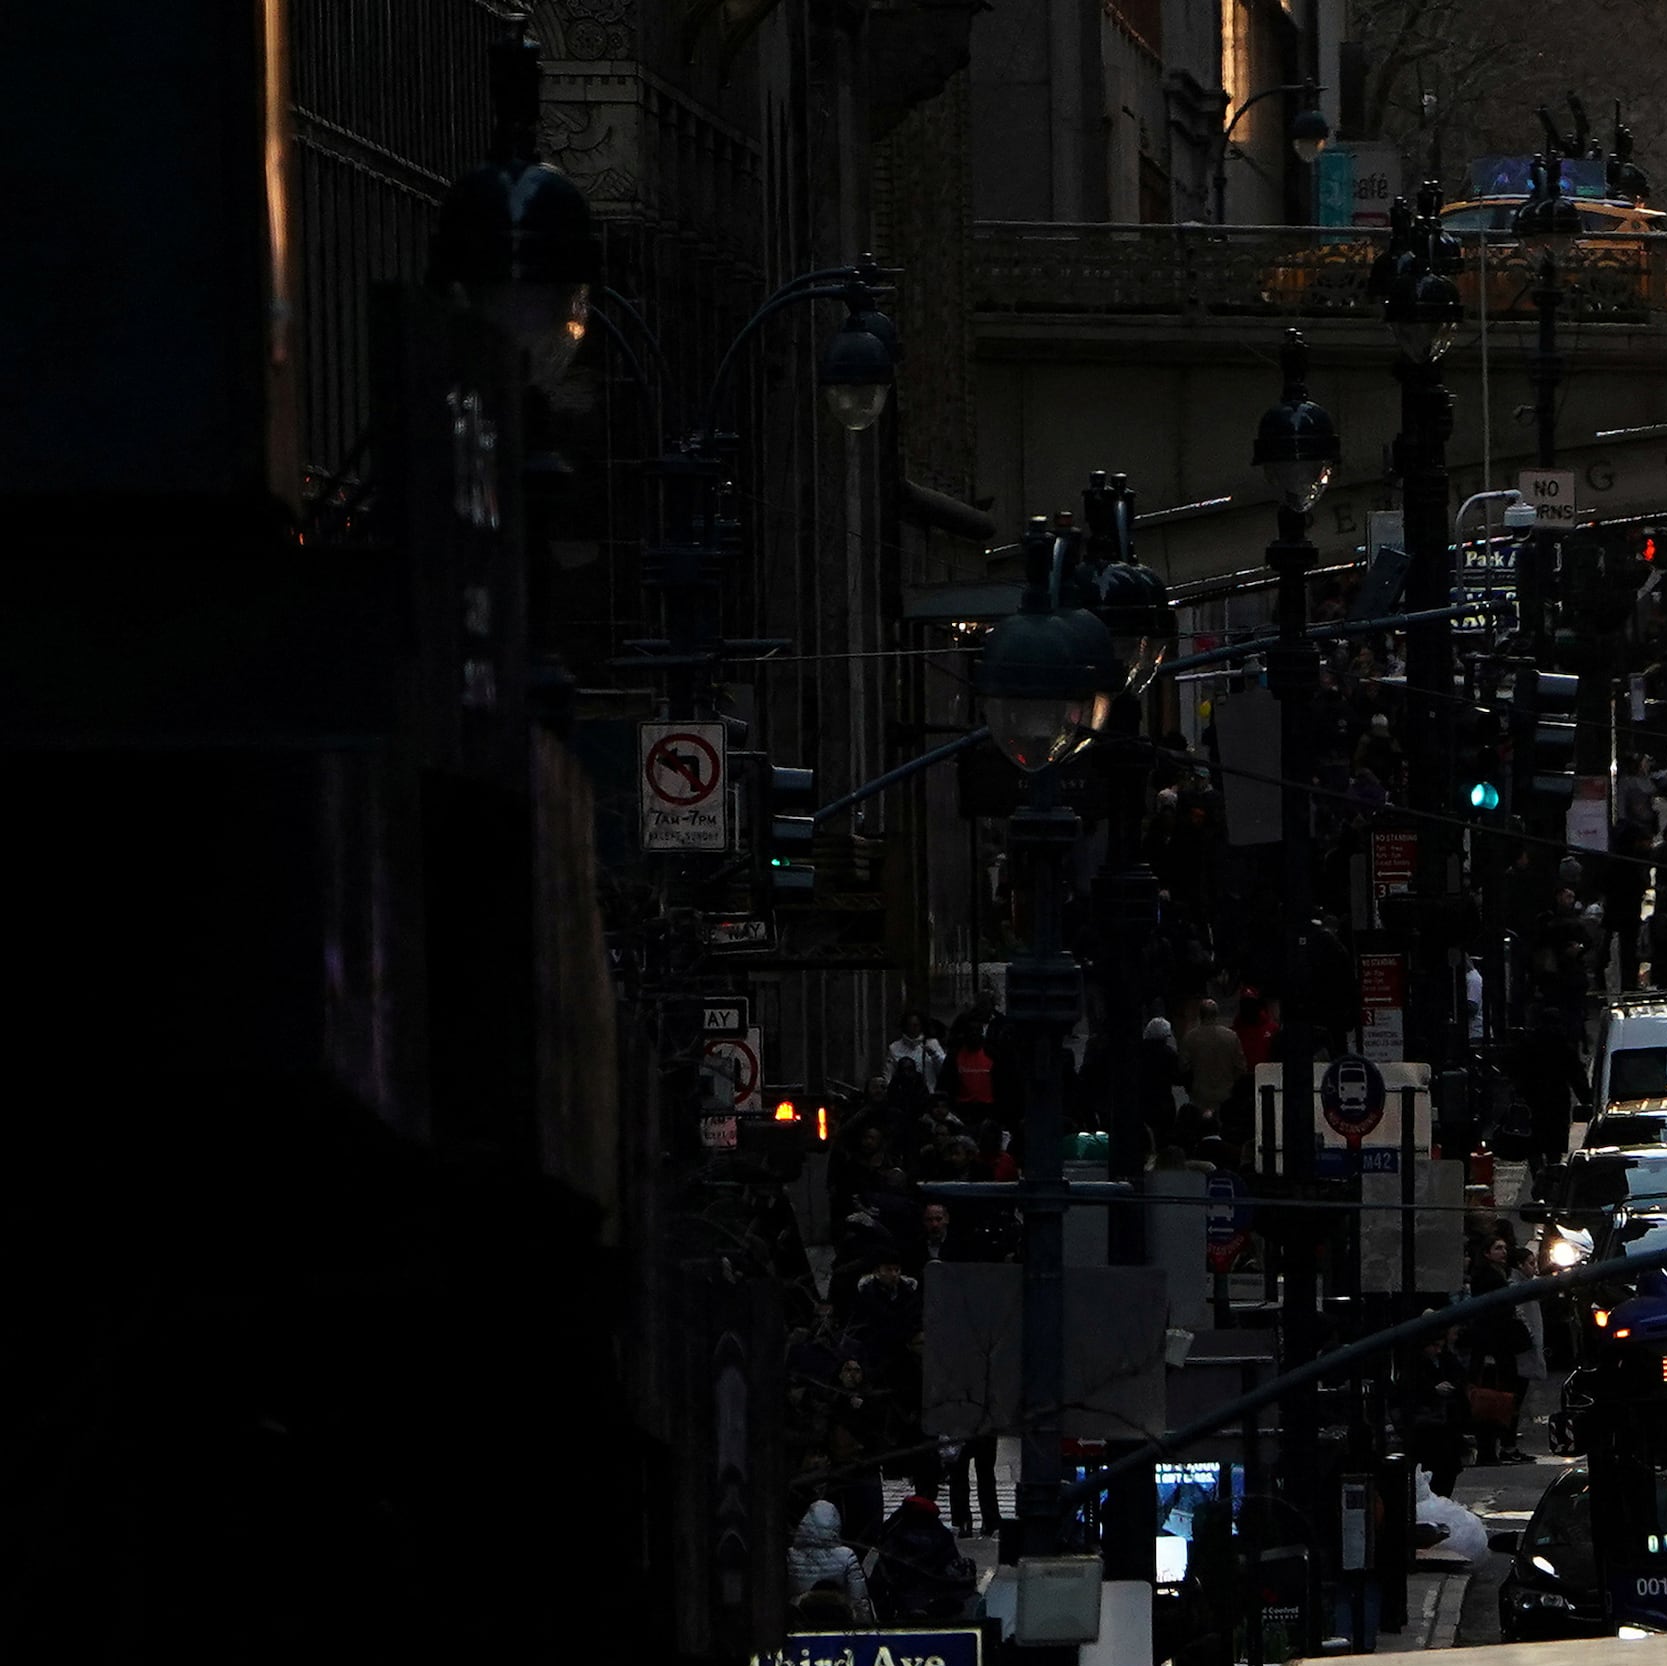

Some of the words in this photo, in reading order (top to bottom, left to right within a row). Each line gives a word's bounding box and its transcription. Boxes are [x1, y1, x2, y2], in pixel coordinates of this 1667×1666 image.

[1353, 171, 1389, 200] afé
[1535, 480, 1559, 497] NO
[1536, 504, 1574, 520] RNS
[1362, 1151, 1393, 1171] M42
